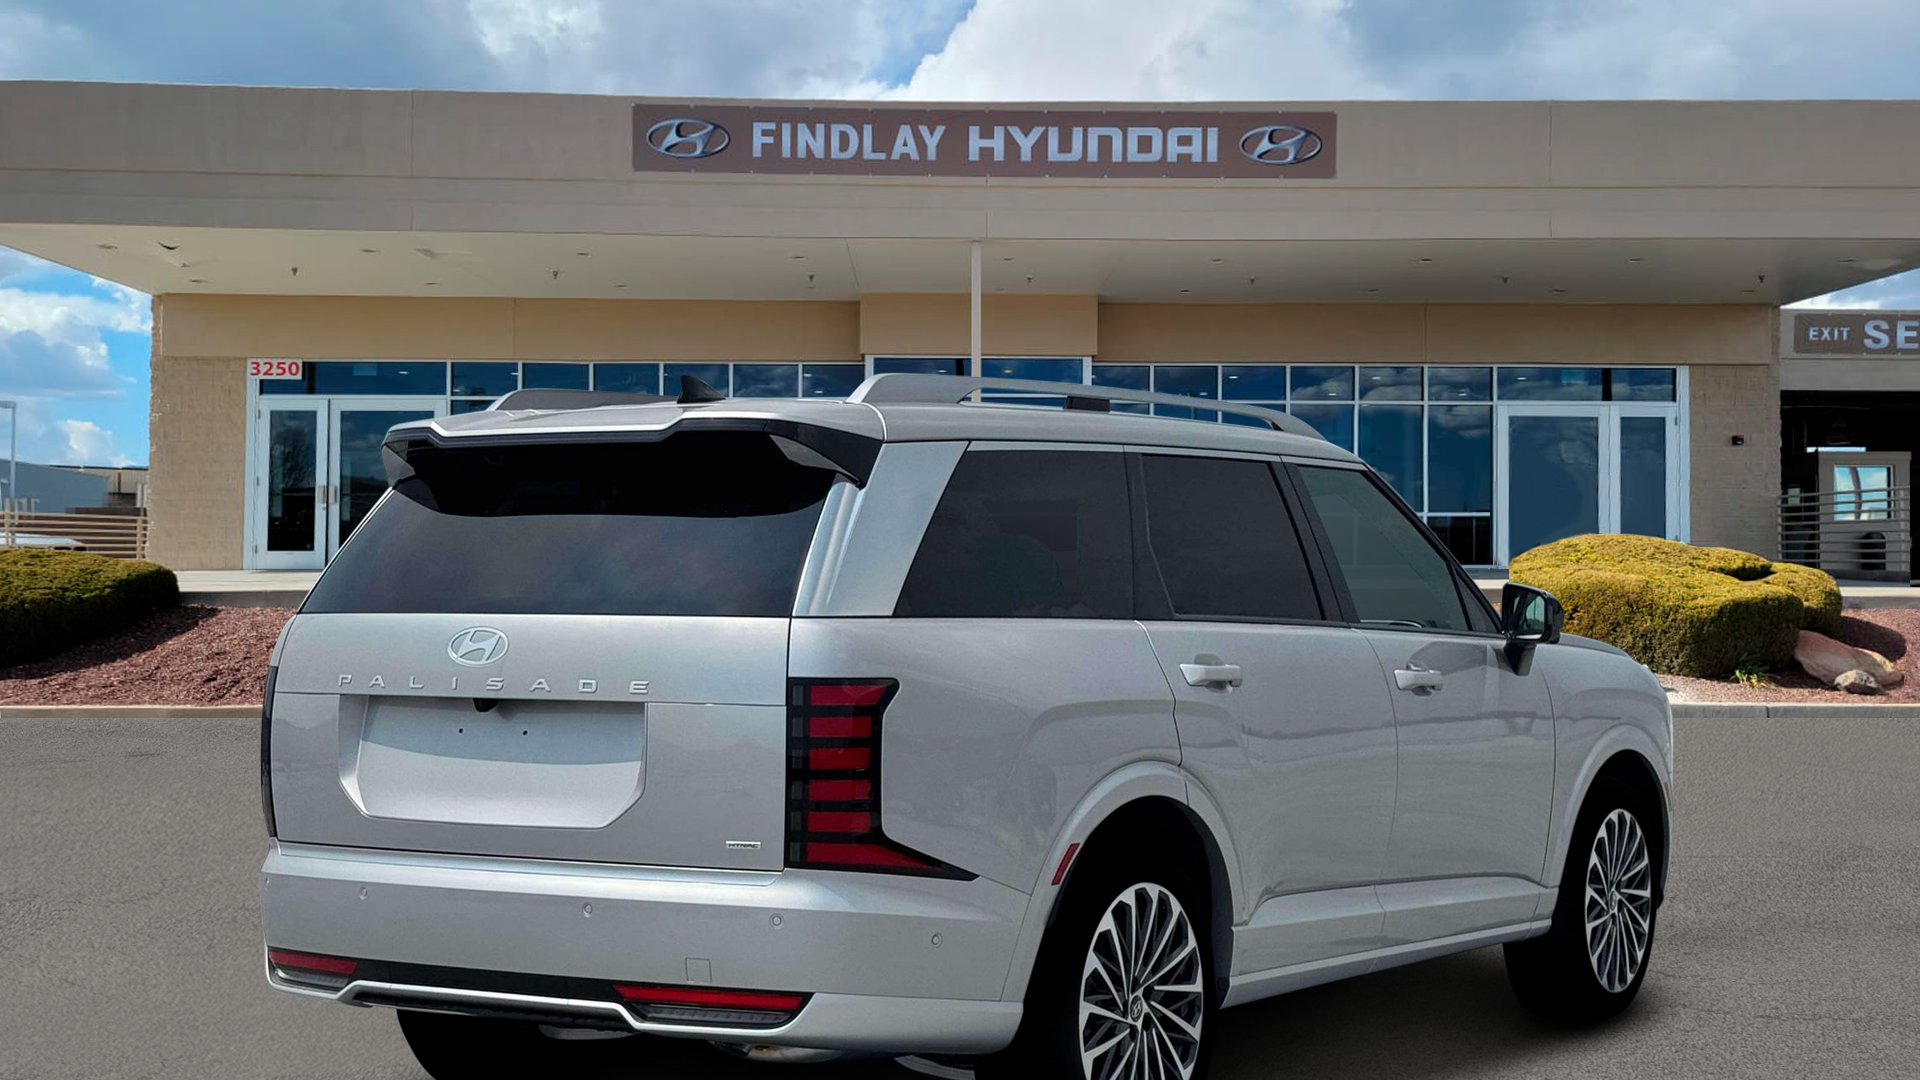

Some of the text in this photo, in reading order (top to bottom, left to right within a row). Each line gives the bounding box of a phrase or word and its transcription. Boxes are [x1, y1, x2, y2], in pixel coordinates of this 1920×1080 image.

[752, 122, 1219, 163] FINDLAY HYUNDAI
[1808, 319, 1920, 350] EXIT SE
[249, 361, 300, 376] 3250
[337, 674, 650, 695] PALISADE
